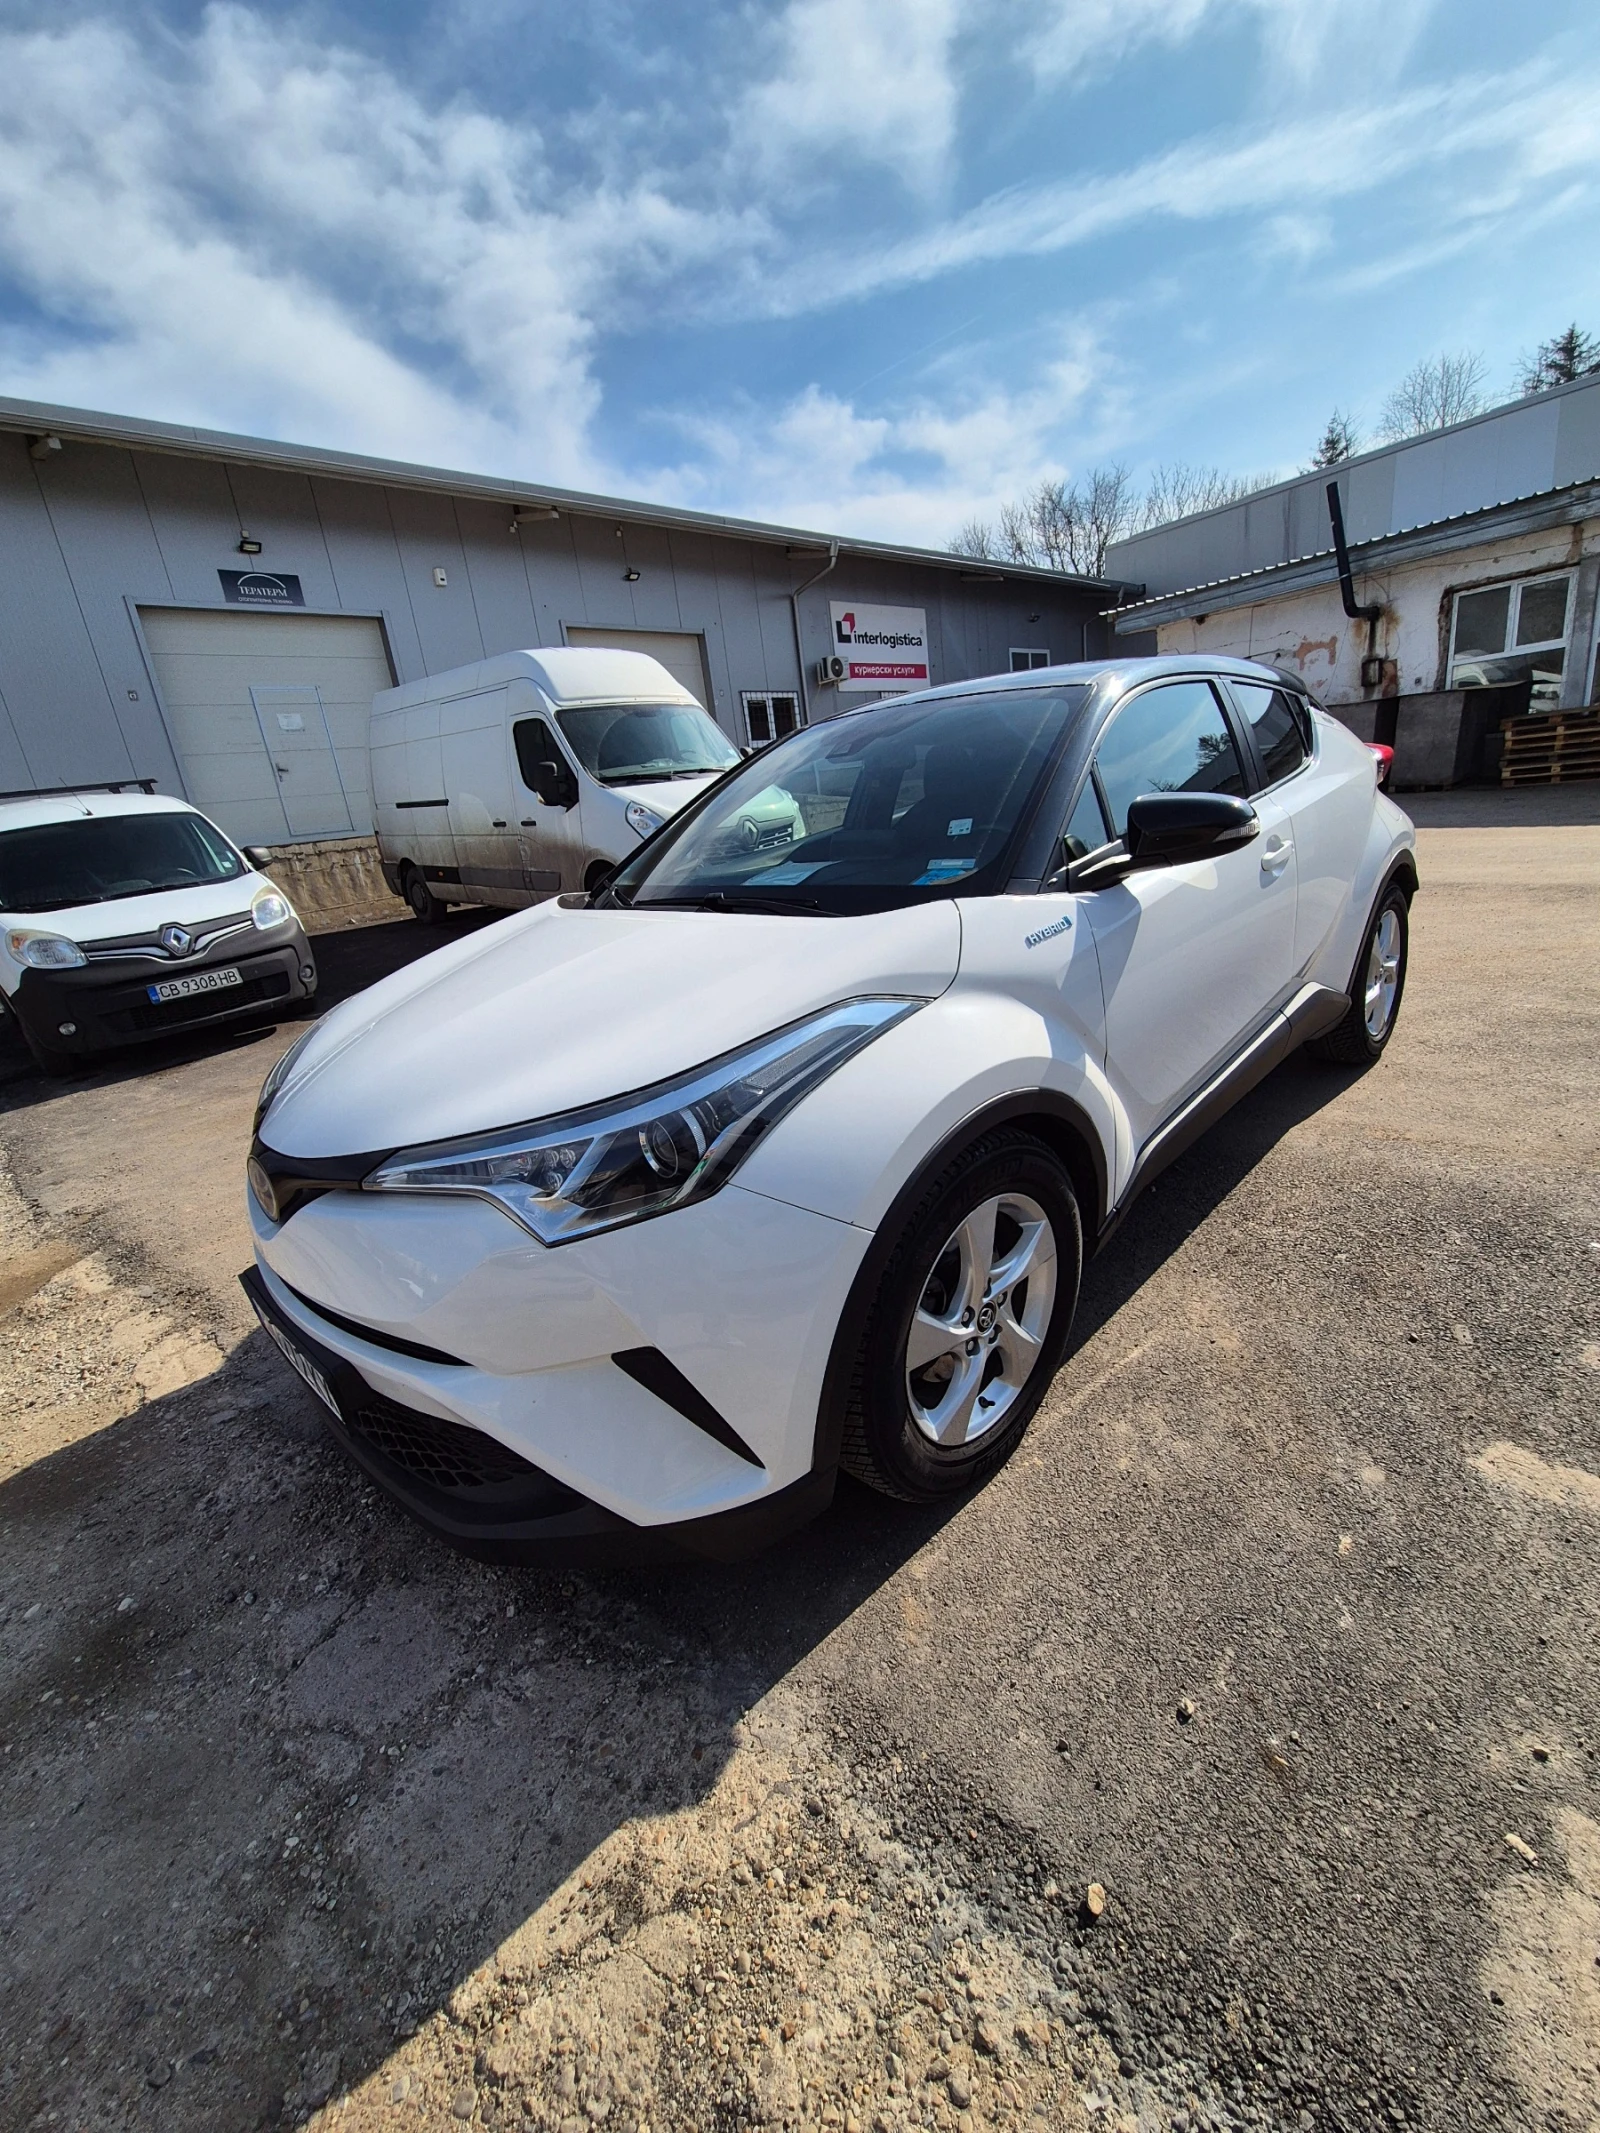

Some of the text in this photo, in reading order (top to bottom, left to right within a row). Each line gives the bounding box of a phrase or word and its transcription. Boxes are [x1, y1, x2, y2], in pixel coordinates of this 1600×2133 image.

[238, 586, 288, 597] ТЕРАТЕРМ
[854, 631, 922, 649] interlogistica
[854, 666, 915, 675] куриерски услуги
[1028, 919, 1069, 944] HYBRID
[159, 970, 238, 998] CB 9308 HB
